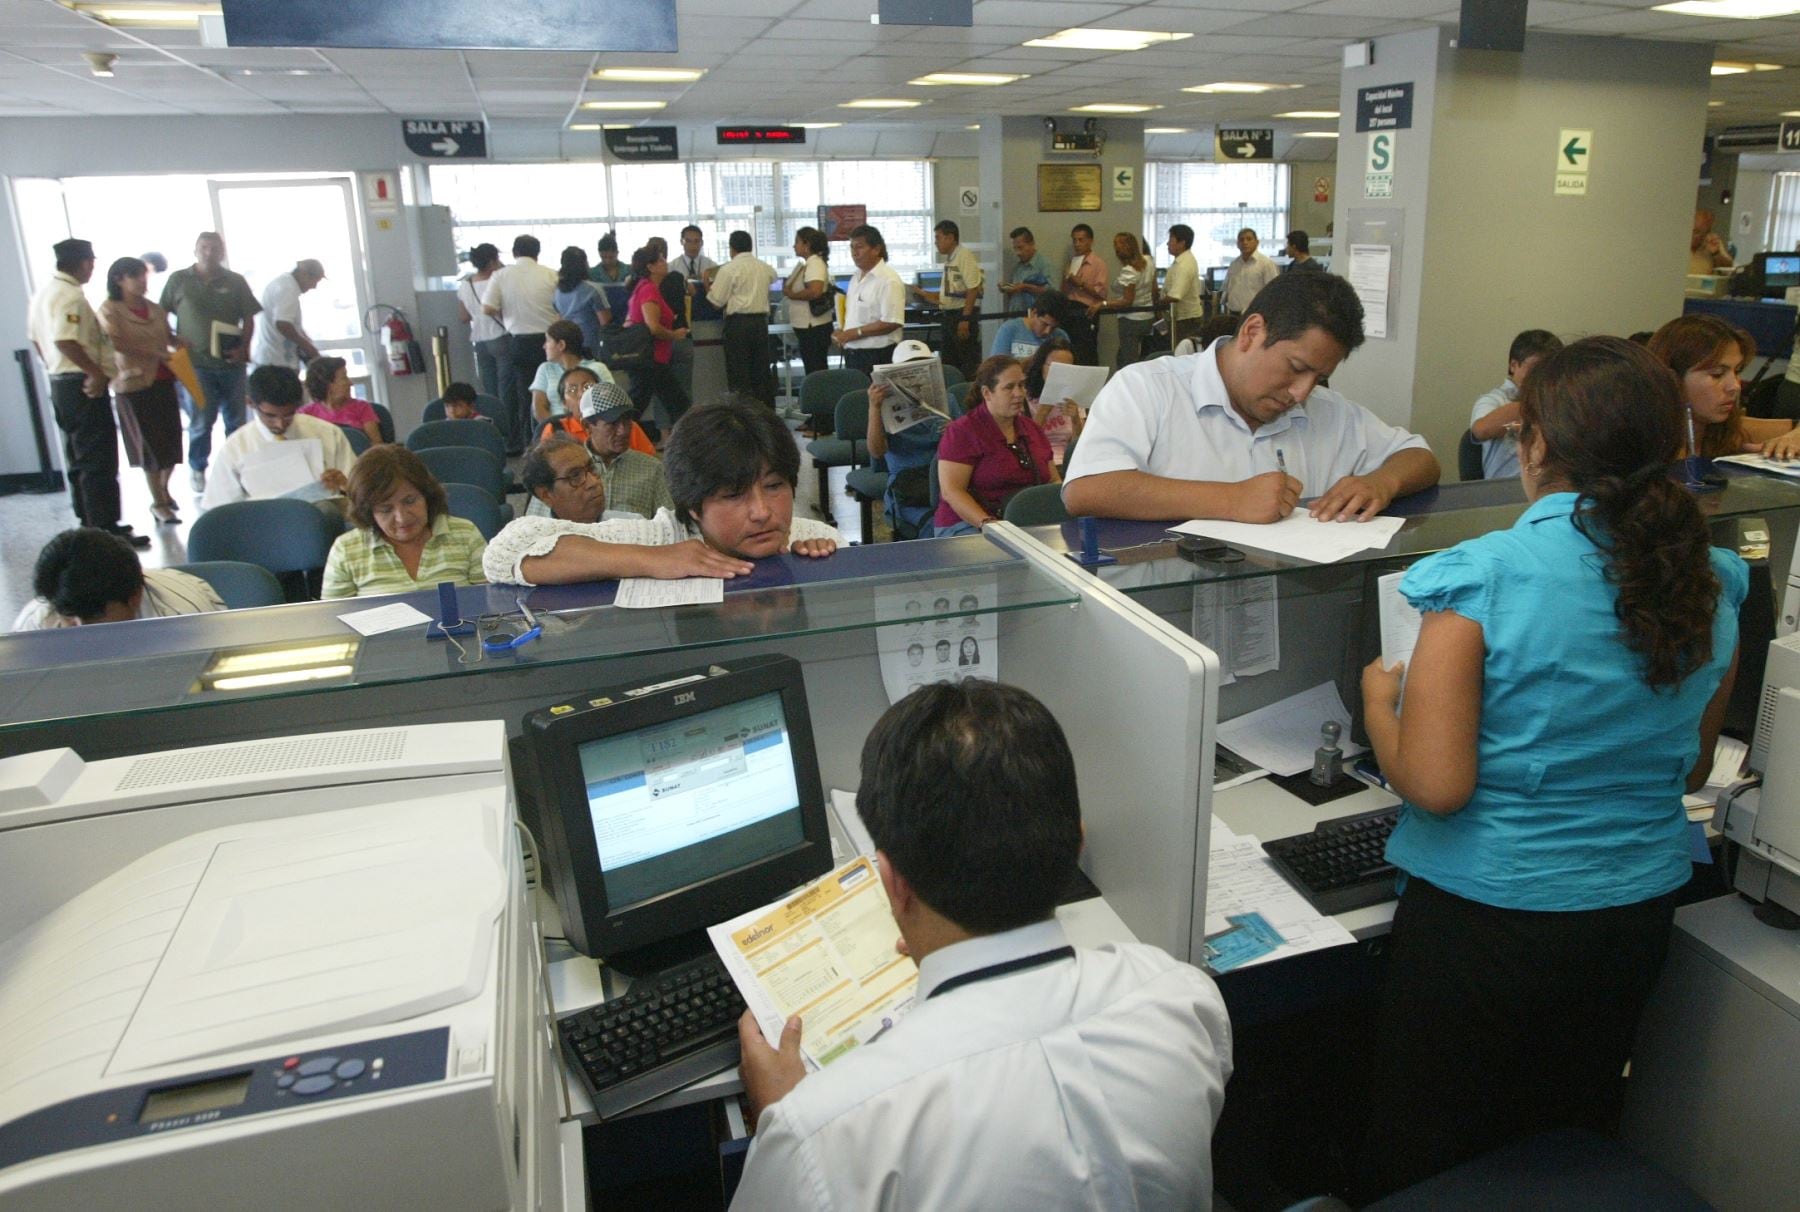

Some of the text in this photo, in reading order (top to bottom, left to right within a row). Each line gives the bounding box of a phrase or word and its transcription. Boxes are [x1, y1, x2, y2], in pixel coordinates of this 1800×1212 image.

[407, 122, 447, 135] SALA
[472, 122, 481, 134] 3
[1222, 130, 1249, 140] SALA
[1264, 130, 1272, 140] 3
[1372, 135, 1390, 172] S
[1557, 180, 1585, 188] SALIDA
[674, 691, 696, 706] IBM
[742, 923, 774, 946] edelnor
[149, 1117, 191, 1132] Phaser
